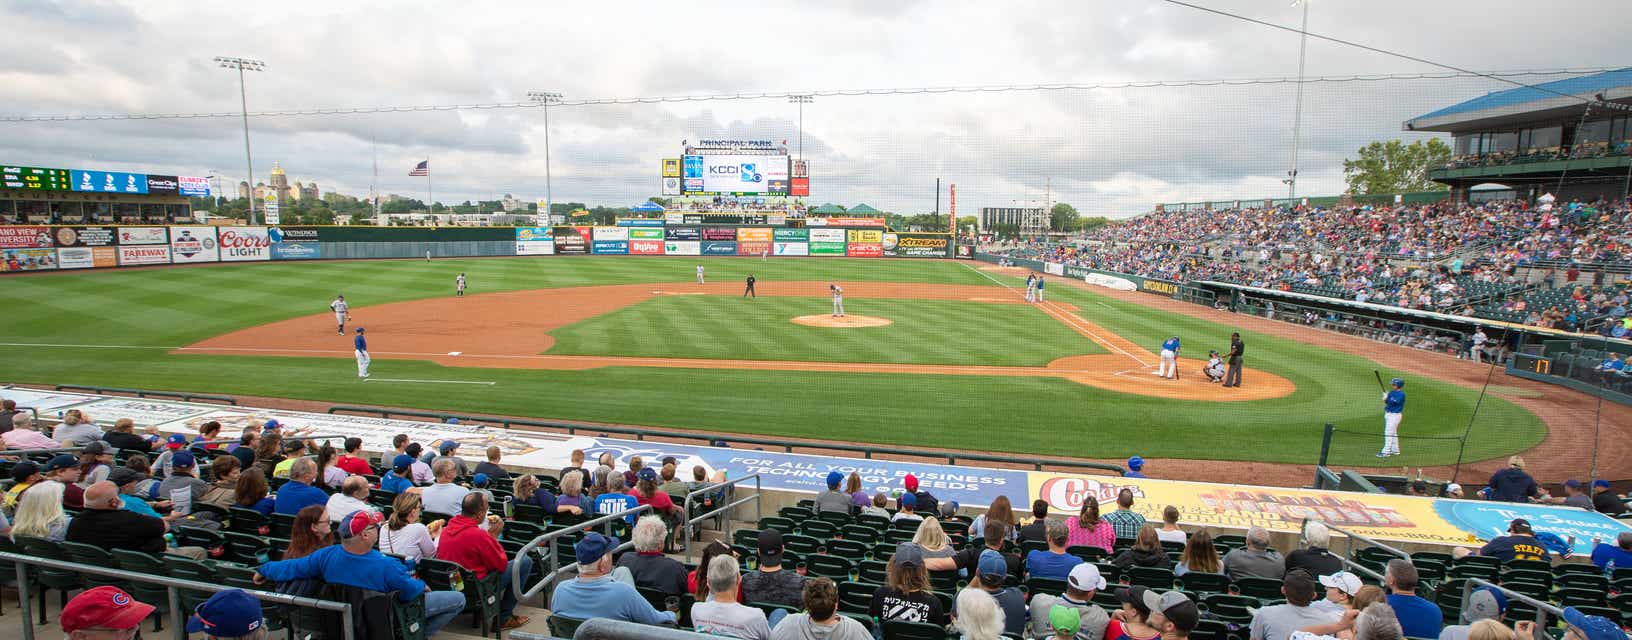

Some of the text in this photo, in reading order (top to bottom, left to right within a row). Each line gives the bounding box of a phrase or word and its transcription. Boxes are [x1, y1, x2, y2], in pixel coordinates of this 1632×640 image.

[709, 165, 739, 174] KCCI
[219, 230, 270, 249] Coors
[123, 249, 167, 258] FAREWAY
[230, 248, 262, 257] LIGHT
[729, 457, 1007, 485] FOR ALL YOUR BUSINESS
[1513, 543, 1545, 556] STAFF
